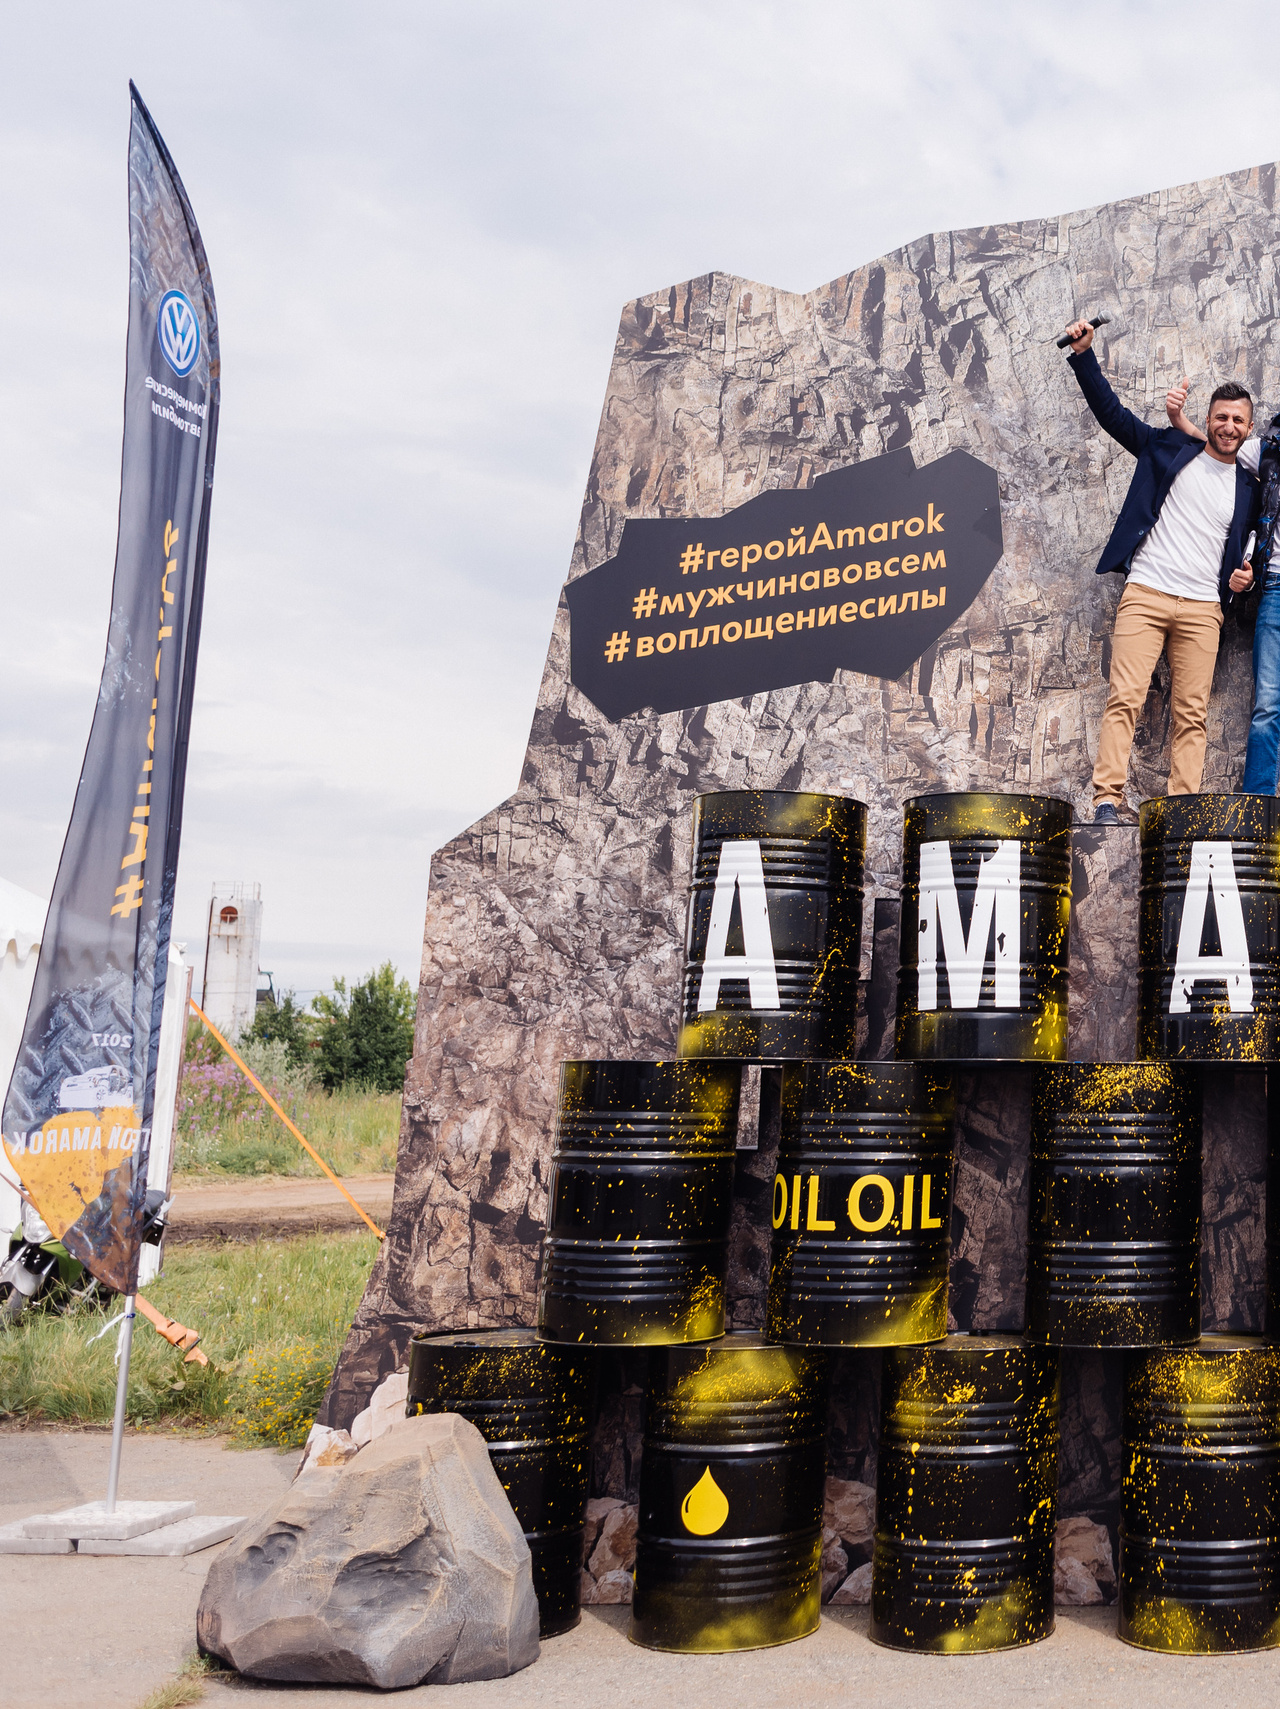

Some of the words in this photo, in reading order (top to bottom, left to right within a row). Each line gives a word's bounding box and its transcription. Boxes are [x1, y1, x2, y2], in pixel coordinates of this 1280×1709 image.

[679, 503, 946, 574] #геройAmarok
[632, 549, 947, 619] #мужчинавовсем
[772, 1173, 836, 1231] OIL
[848, 1174, 942, 1232] OIL
